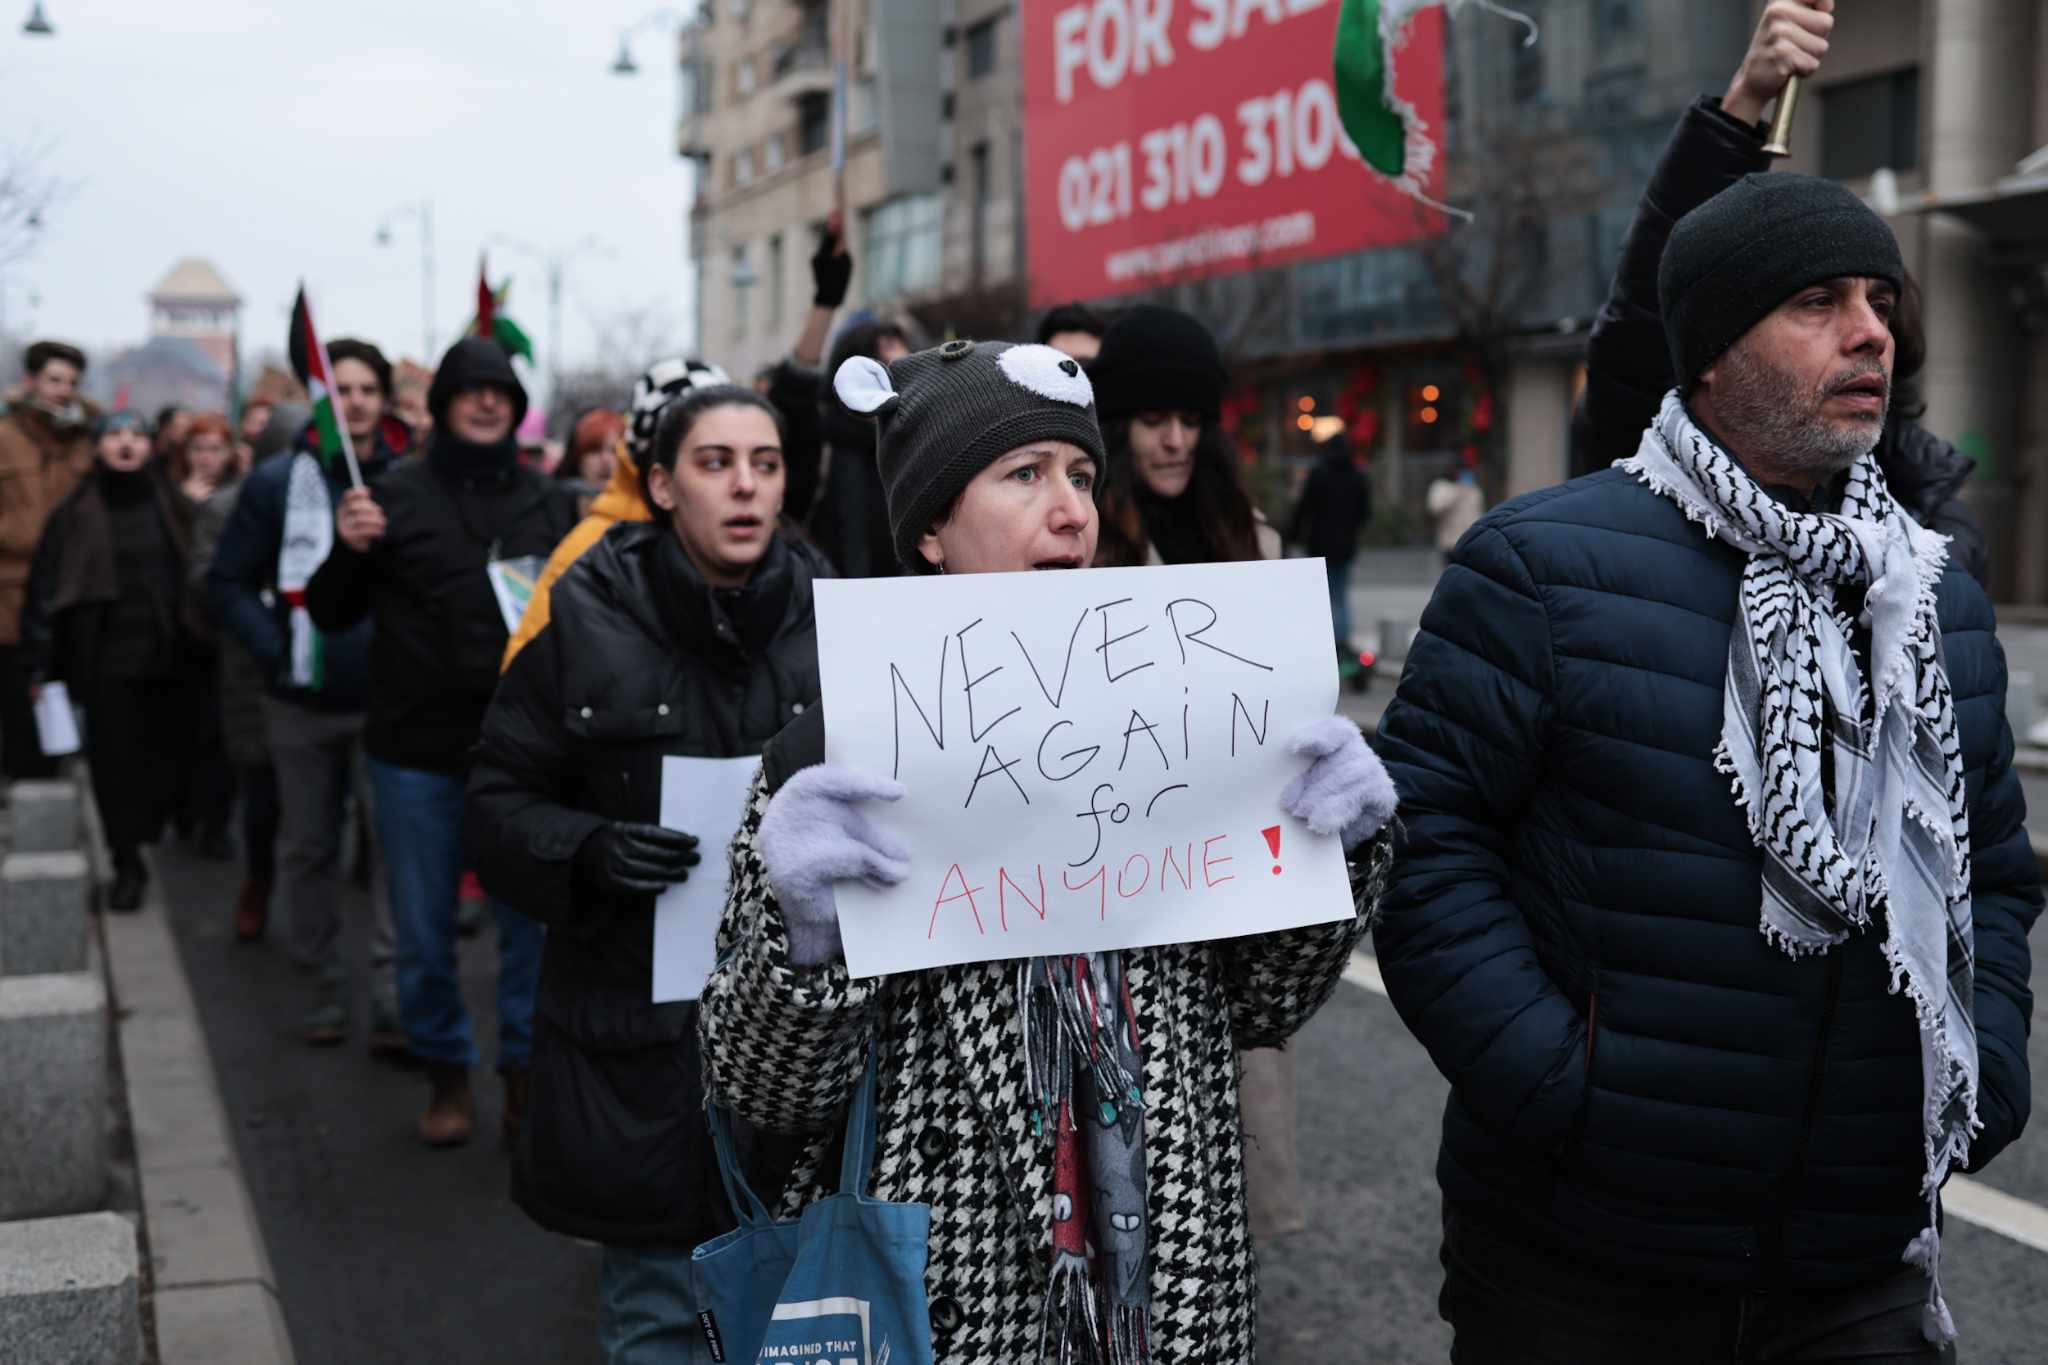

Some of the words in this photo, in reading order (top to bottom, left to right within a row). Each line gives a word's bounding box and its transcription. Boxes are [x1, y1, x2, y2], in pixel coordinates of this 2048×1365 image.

[1055, 0, 1175, 102] FOR
[1059, 141, 1132, 232] 021
[1141, 113, 1227, 210] 310
[1237, 79, 1361, 187] 310
[889, 597, 1274, 781] NEVER
[1067, 783, 1189, 868] for
[825, 1340, 857, 1353] THAT
